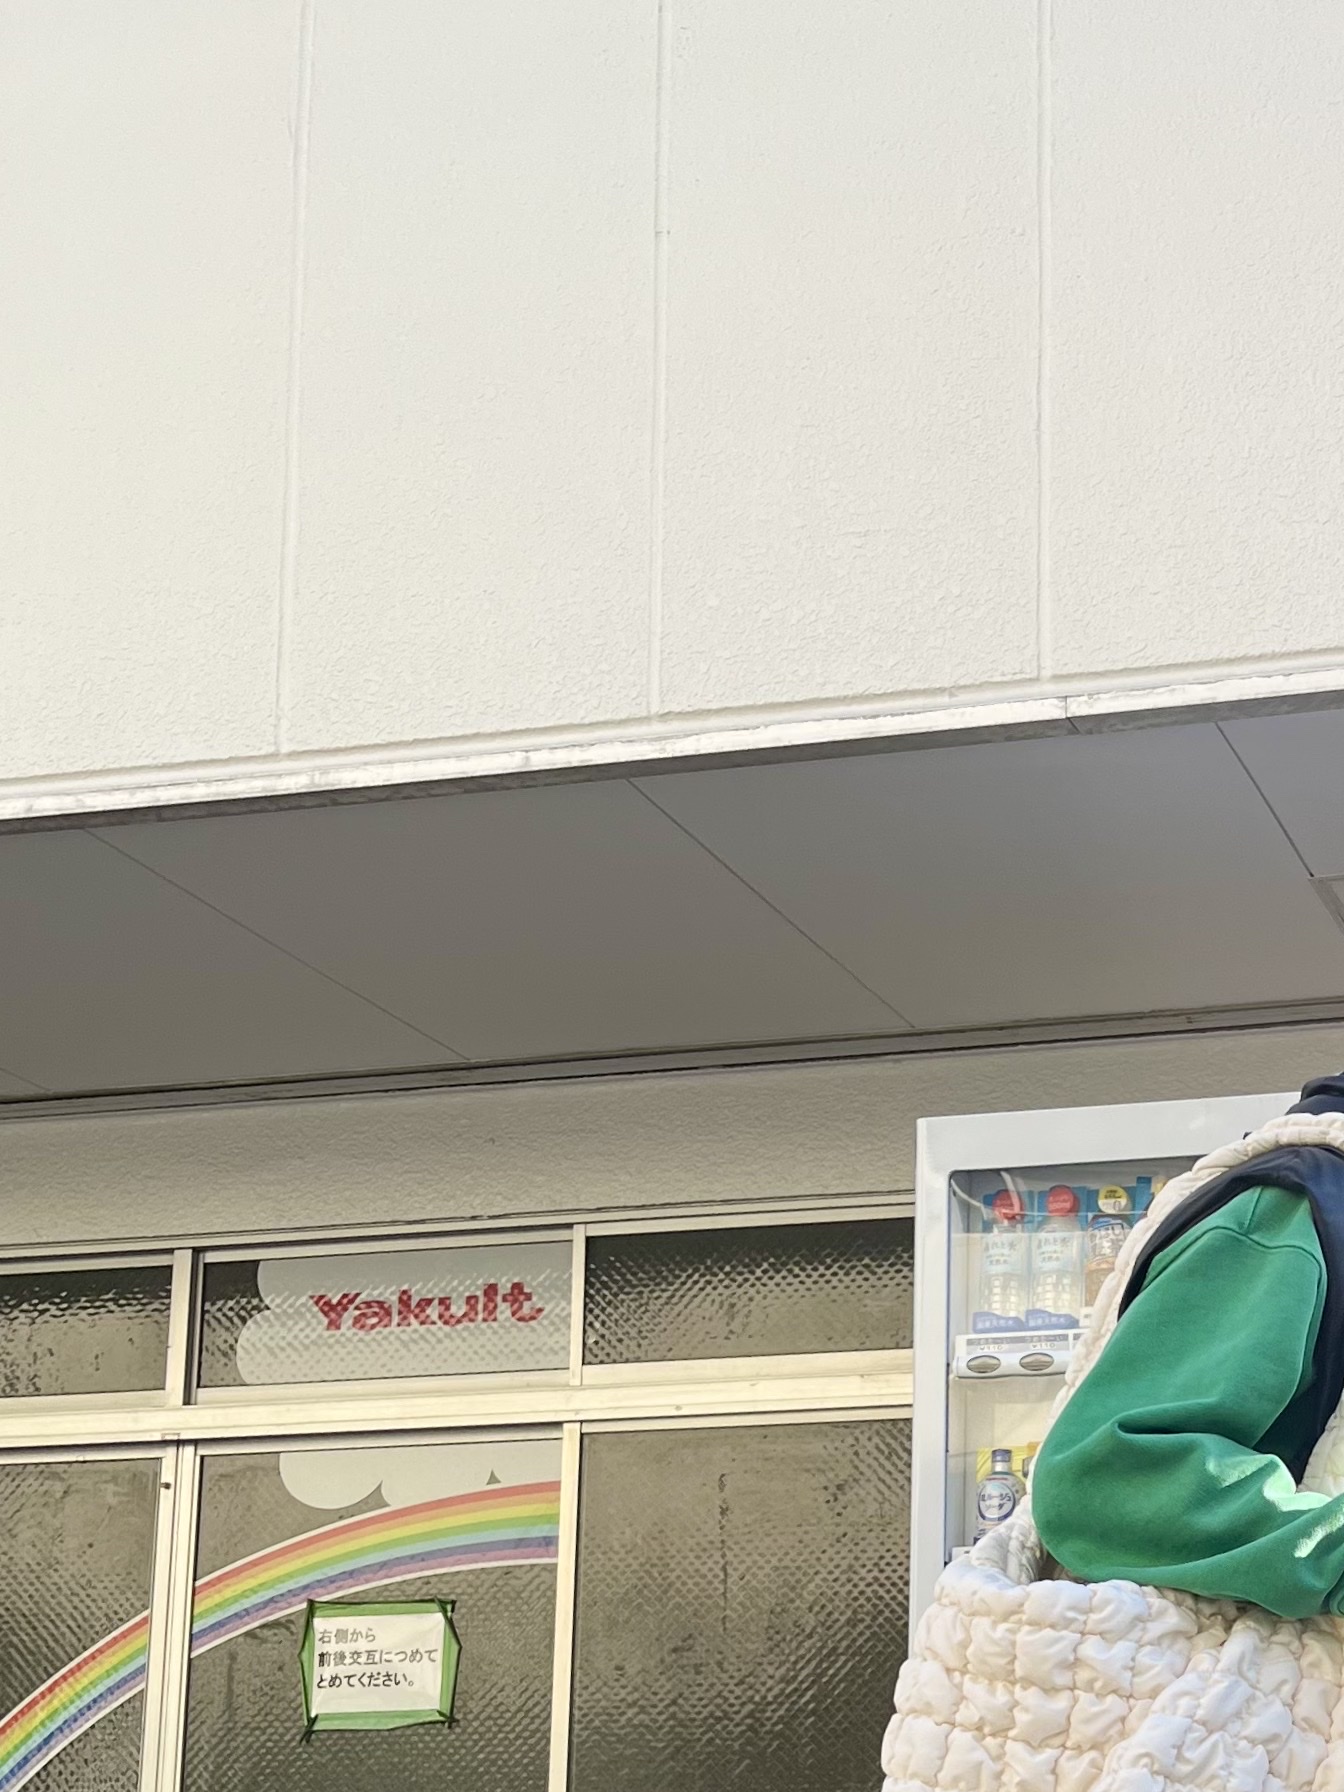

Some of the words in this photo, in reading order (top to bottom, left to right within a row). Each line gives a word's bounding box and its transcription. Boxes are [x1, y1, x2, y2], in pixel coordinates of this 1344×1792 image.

[308, 1281, 546, 1332] Yakult
[318, 1627, 377, 1645] 右側から
[317, 1648, 439, 1668] 前後交互につめて
[316, 1671, 415, 1689] とめてください。
